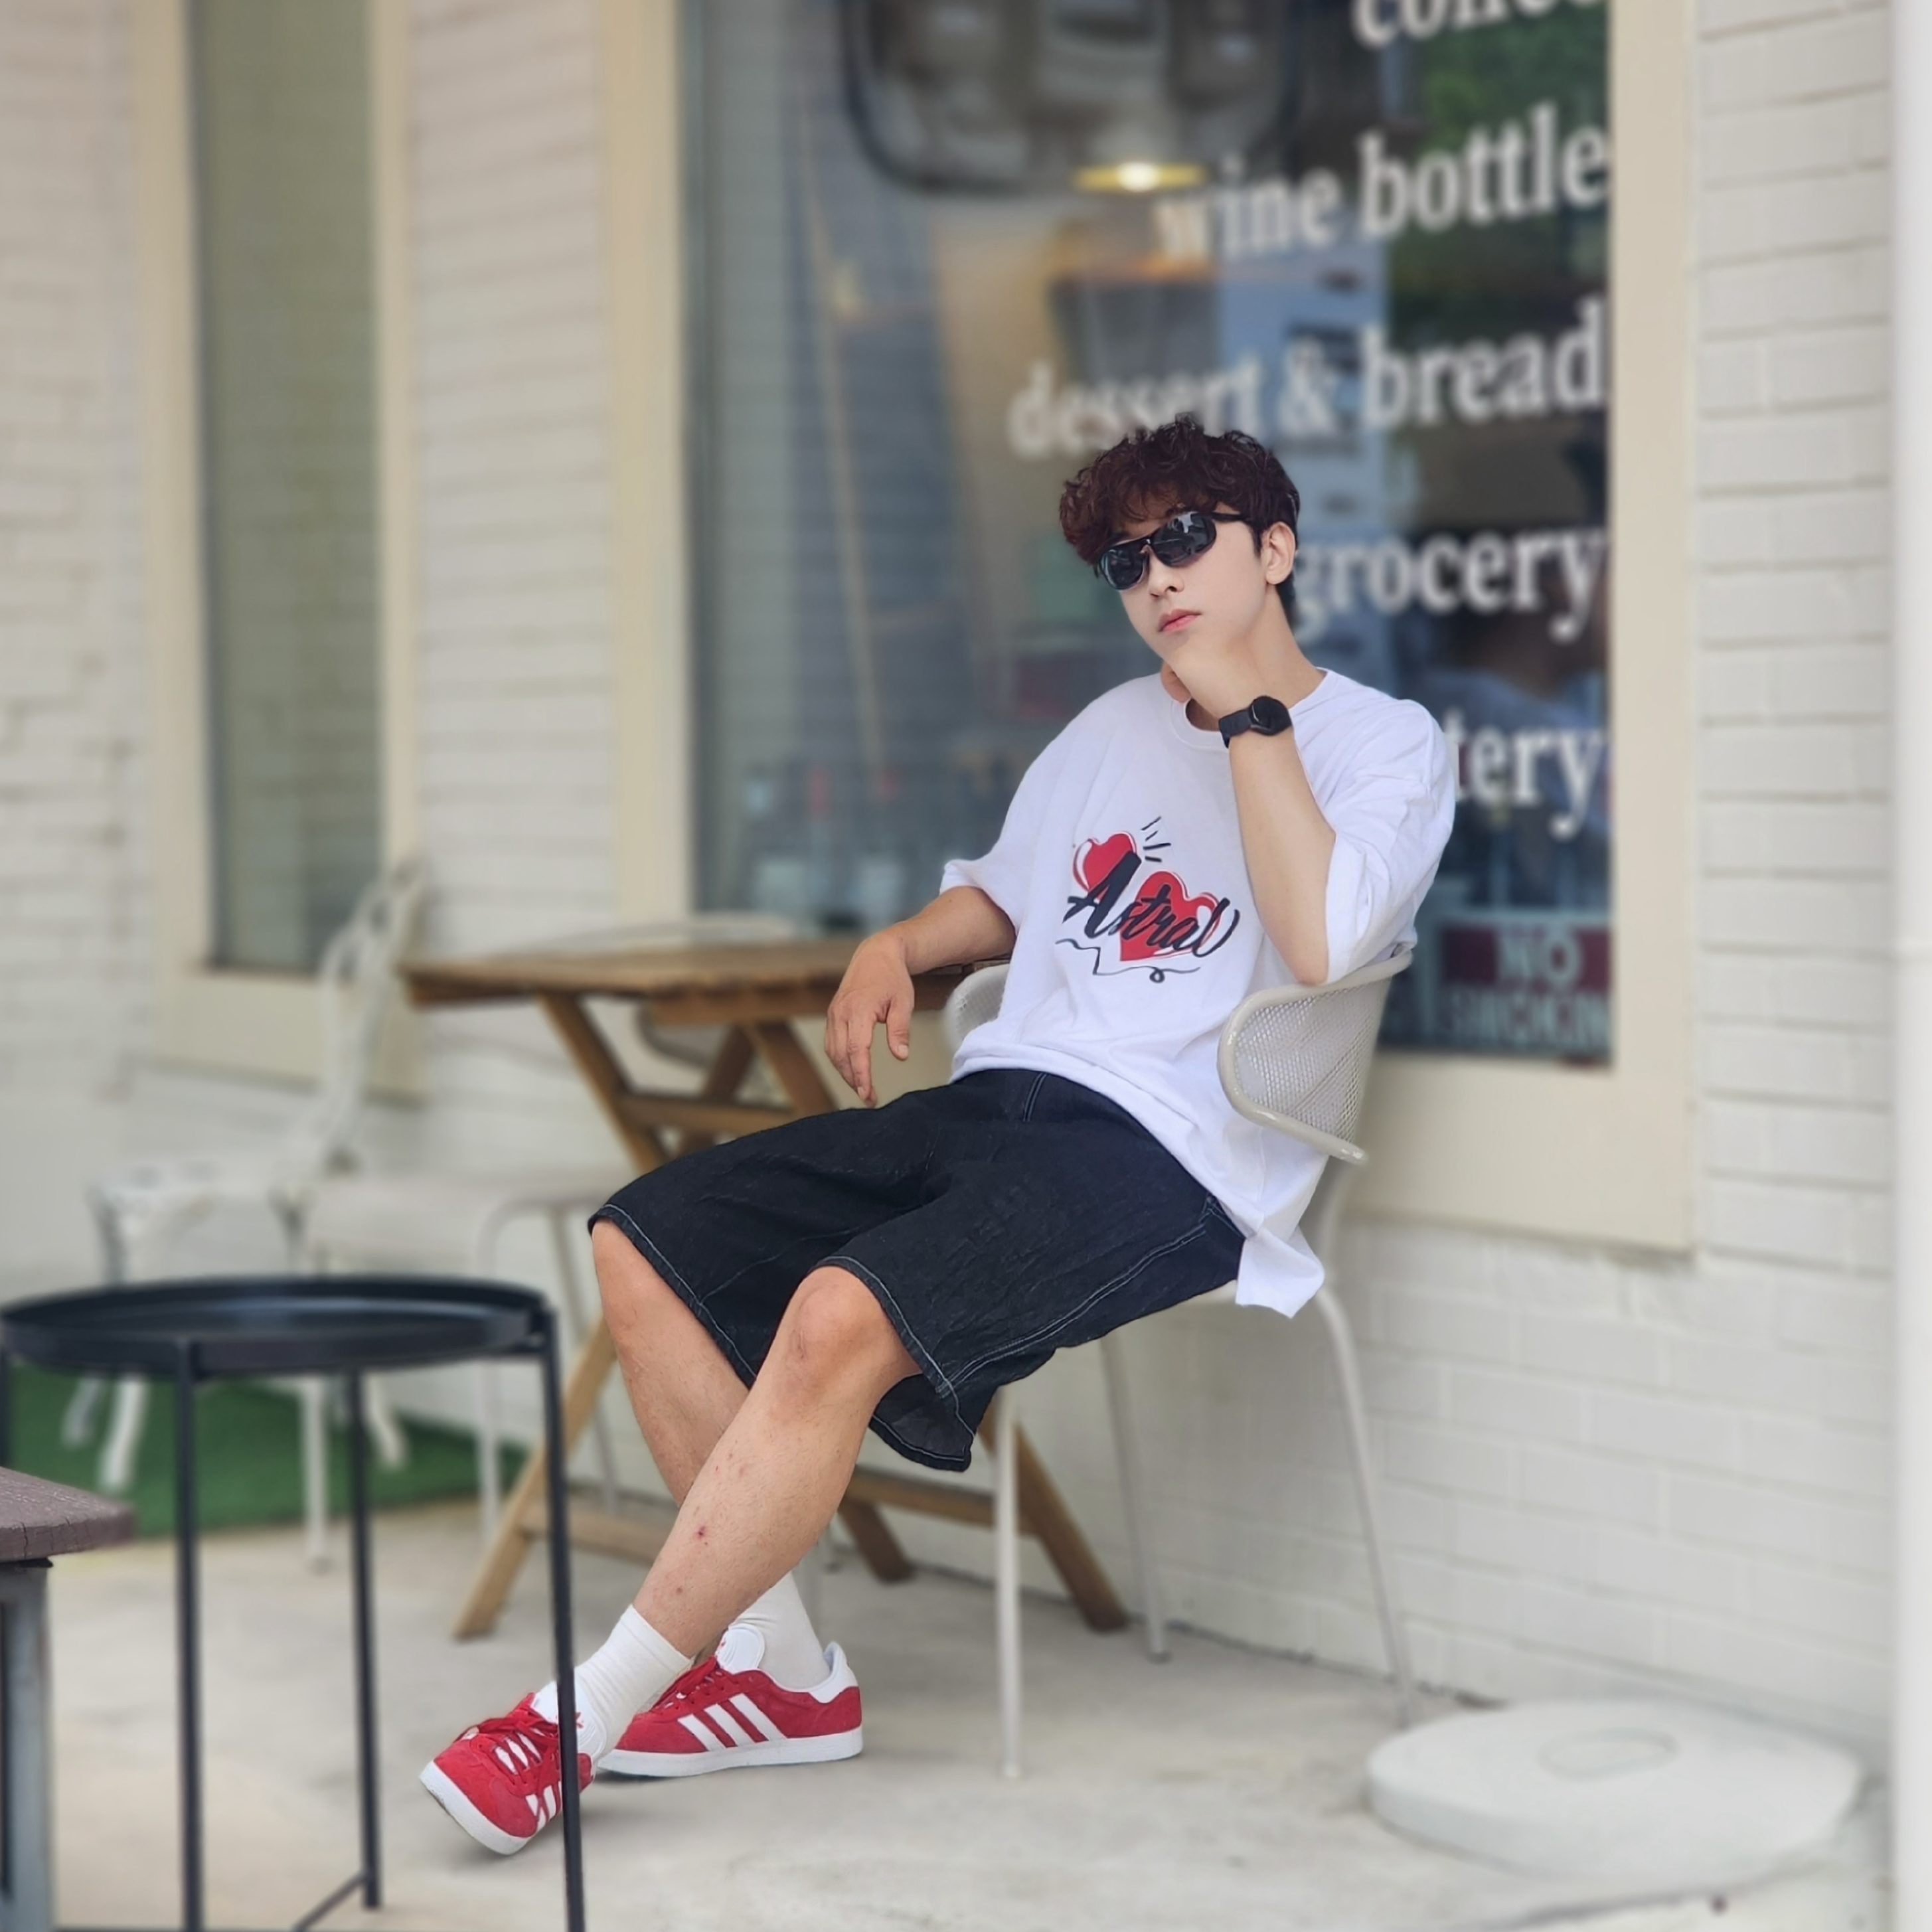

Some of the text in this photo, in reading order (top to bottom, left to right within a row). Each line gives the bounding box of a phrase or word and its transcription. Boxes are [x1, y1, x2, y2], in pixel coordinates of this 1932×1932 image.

[1155, 103, 1609, 258] wine bottle
[1279, 335, 1338, 438] &
[1360, 297, 1603, 426] bread
[1293, 531, 1608, 643] grocery
[1062, 850, 1240, 958] Astral
[1498, 924, 1581, 991] NO
